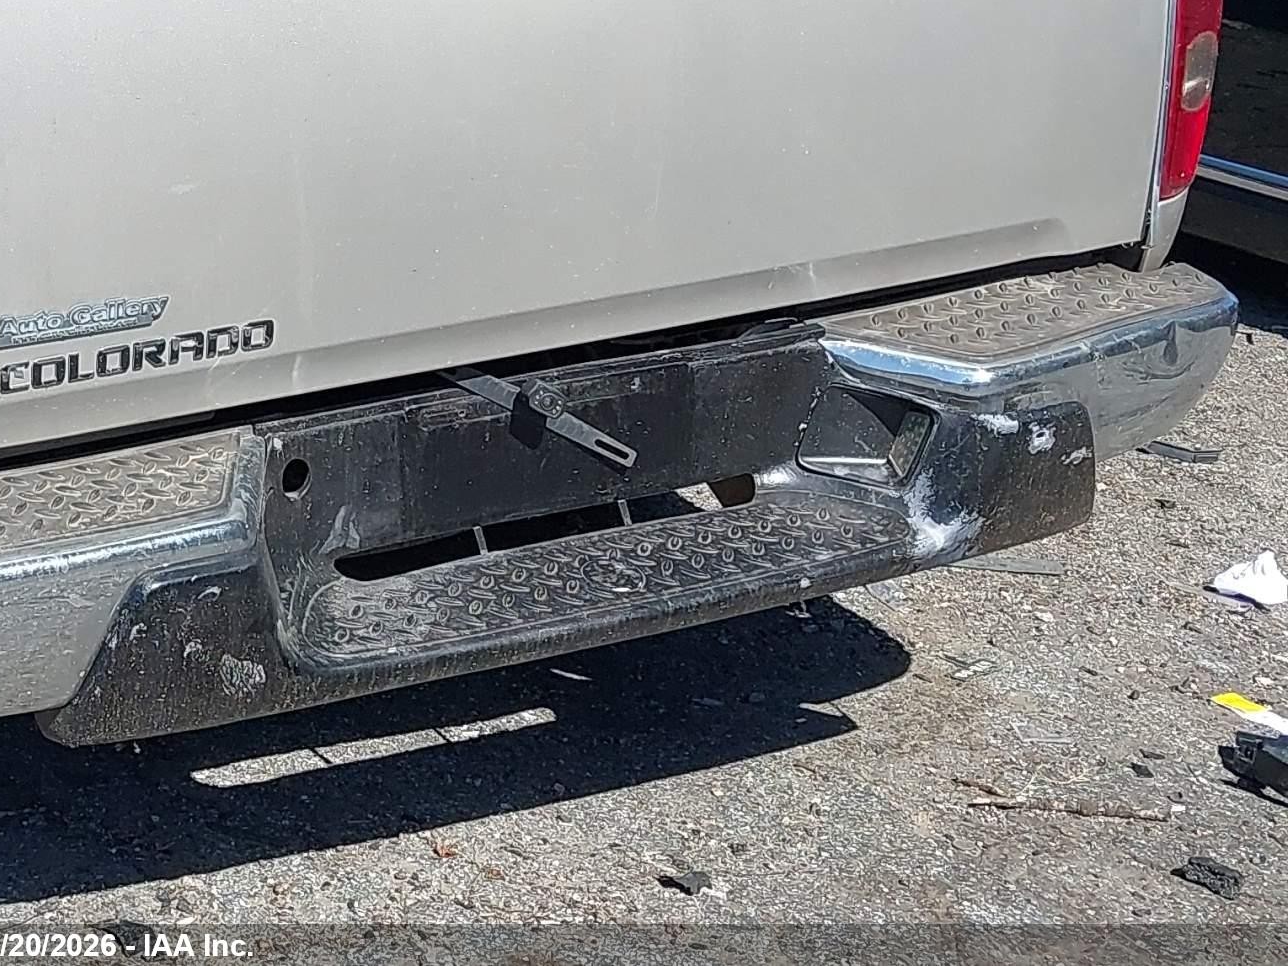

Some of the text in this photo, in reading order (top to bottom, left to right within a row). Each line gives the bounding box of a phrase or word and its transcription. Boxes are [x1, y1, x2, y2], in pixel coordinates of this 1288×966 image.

[0, 310, 63, 337] Auto
[68, 298, 167, 325] Gallery
[0, 320, 275, 395] COLORADO
